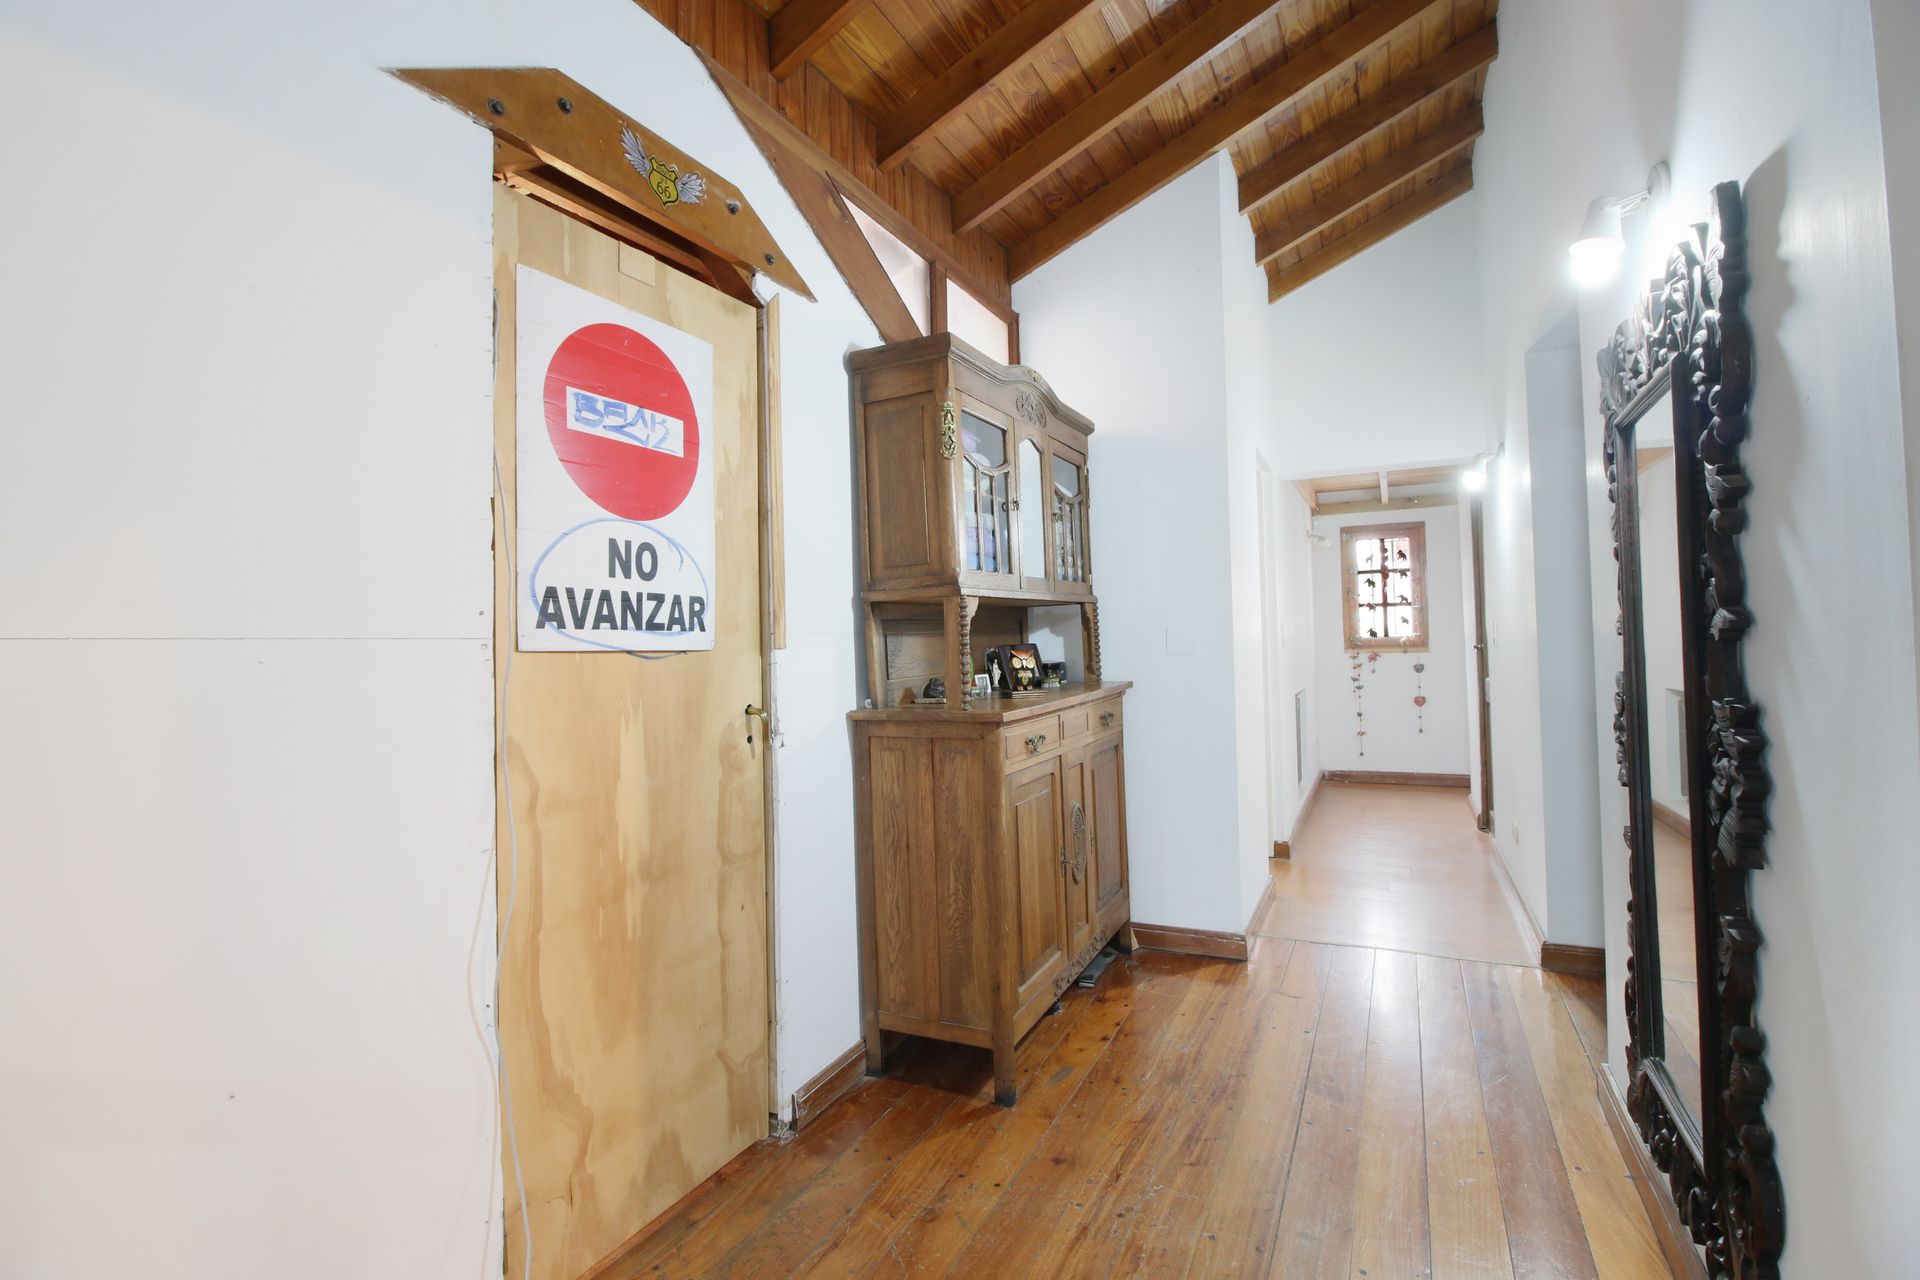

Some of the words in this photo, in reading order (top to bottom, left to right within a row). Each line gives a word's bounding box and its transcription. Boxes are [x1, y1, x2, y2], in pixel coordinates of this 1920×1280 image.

[656, 181, 671, 199] 66
[608, 537, 659, 582] NO
[535, 585, 707, 633] AVANZAR
